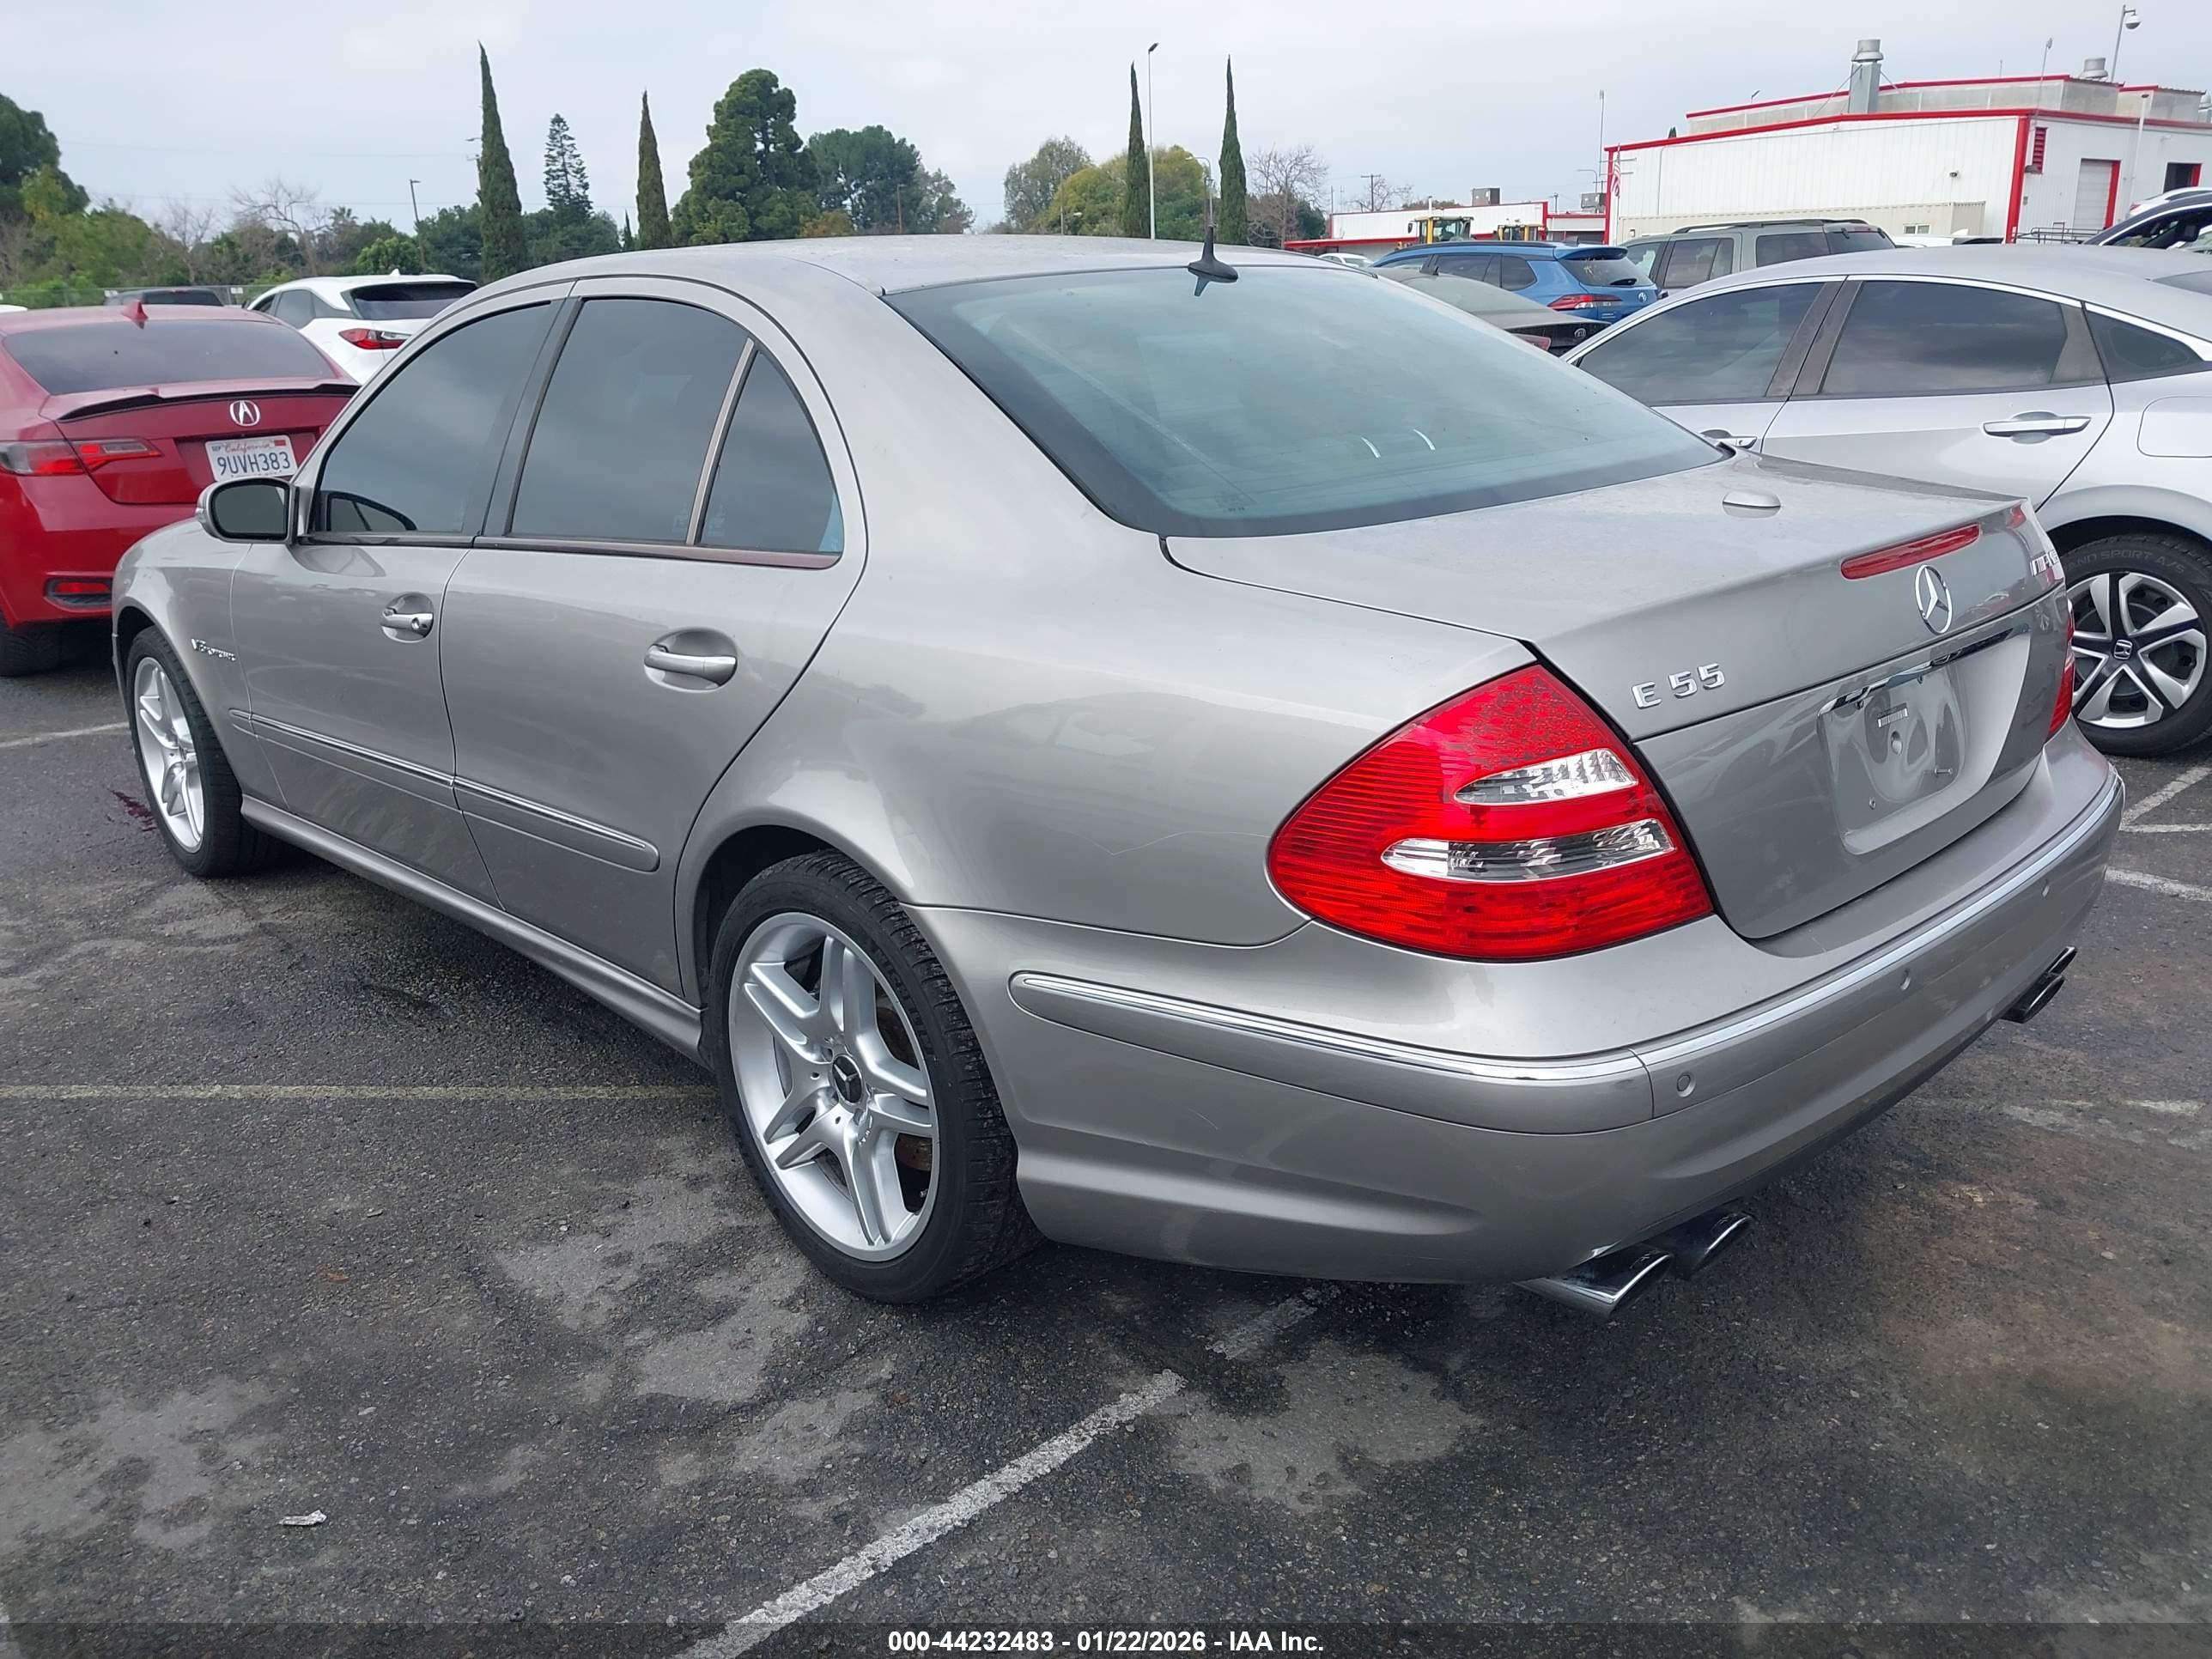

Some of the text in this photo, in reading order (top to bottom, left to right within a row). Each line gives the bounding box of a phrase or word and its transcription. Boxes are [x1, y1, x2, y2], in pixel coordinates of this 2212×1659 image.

[216, 451, 290, 476] 9UVH383
[2103, 549, 2154, 559] SPORT
[2156, 554, 2186, 573] A/S
[1632, 663, 1725, 709] E 55
